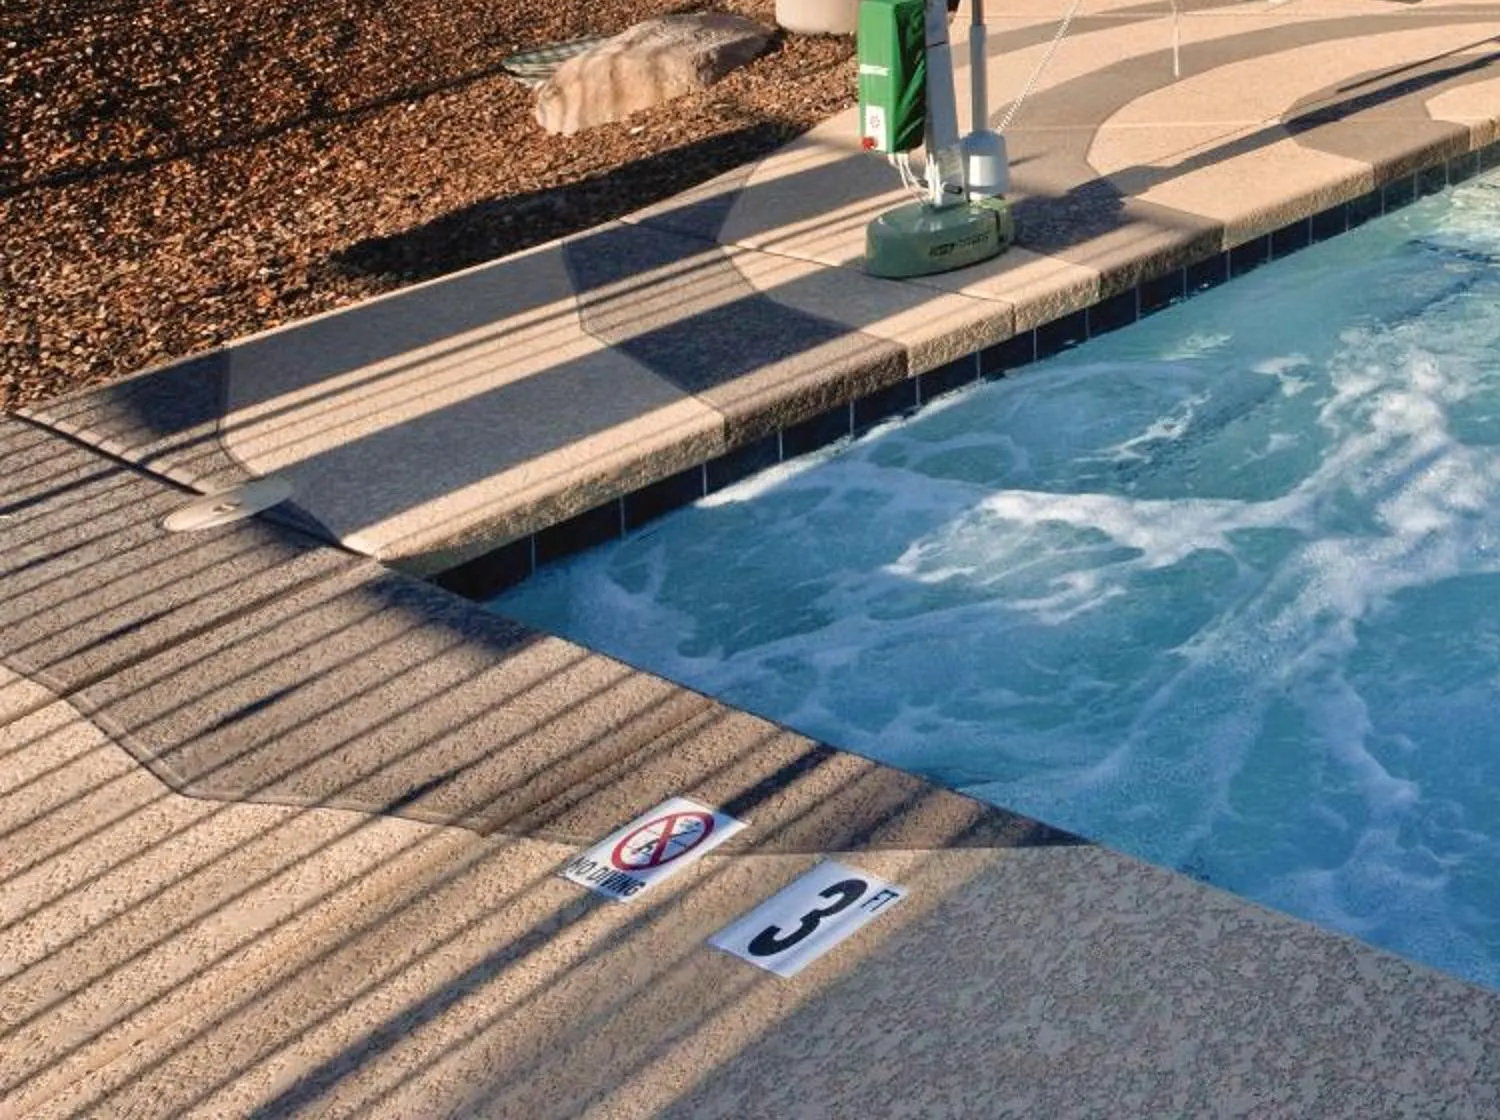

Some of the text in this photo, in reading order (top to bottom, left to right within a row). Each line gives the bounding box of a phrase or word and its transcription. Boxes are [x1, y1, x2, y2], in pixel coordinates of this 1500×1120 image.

[565, 855, 647, 897] NO DIVING
[747, 878, 899, 958] 3 FT
